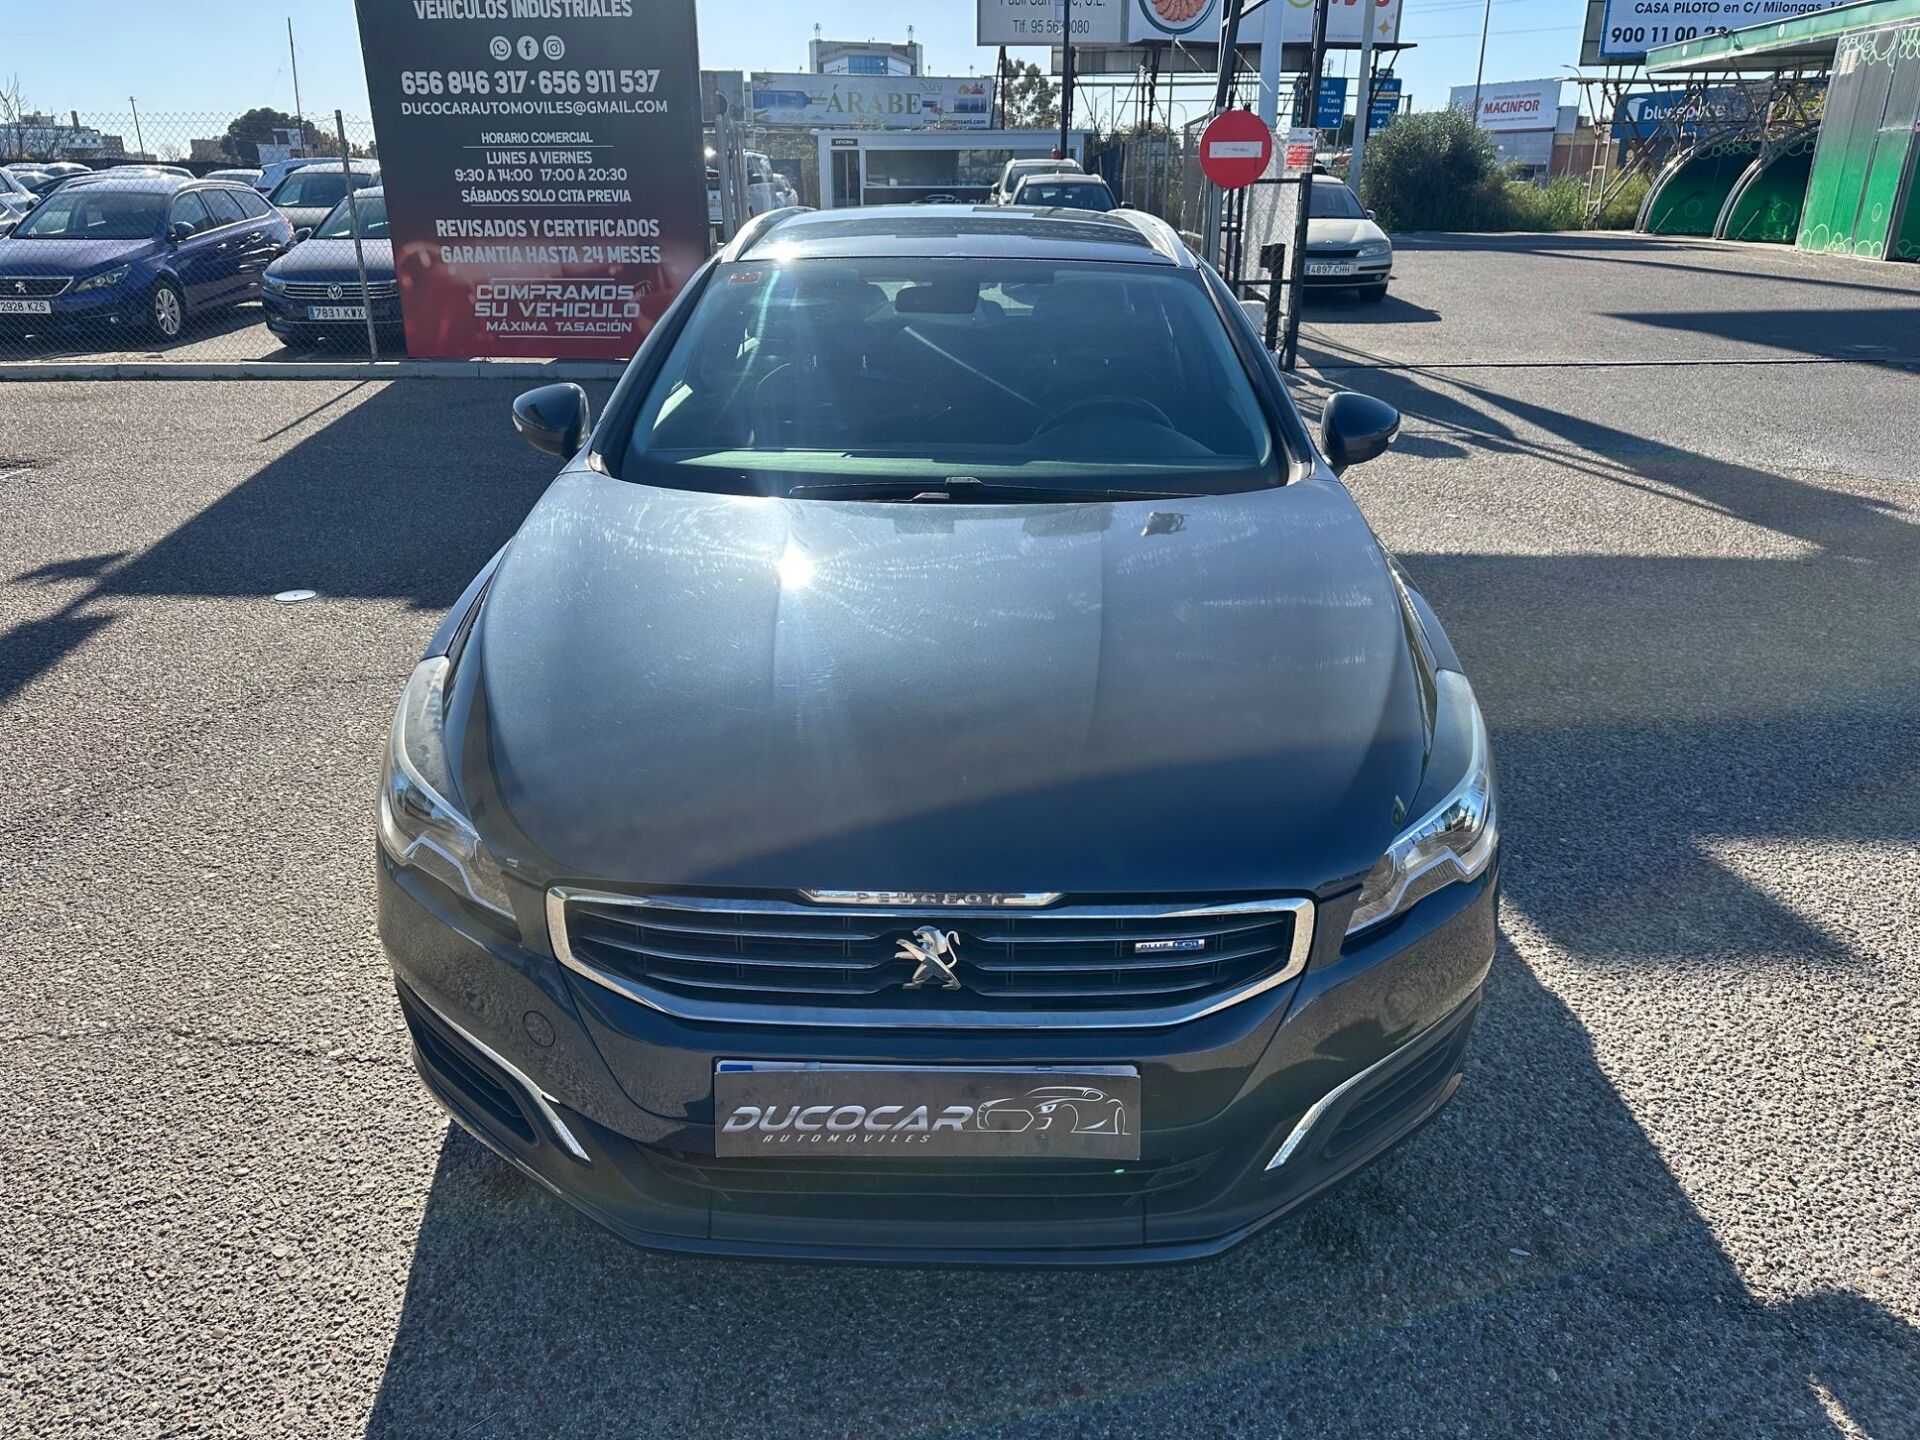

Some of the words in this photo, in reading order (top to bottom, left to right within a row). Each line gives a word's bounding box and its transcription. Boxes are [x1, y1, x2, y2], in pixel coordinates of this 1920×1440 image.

[512, 0, 633, 18] INDUSTRIALES
[1635, 3, 1669, 13] CASA
[1673, 2, 1719, 13] PILOTO
[1724, 5, 1739, 13] en
[1743, 2, 1760, 13] C/
[1013, 20, 1028, 33] Tlf.
[1031, 20, 1043, 33] 95
[1046, 20, 1090, 33] 56080
[1611, 28, 1645, 43] 900
[1651, 27, 1669, 42] 11
[1674, 26, 1697, 41] 00
[401, 71, 444, 95] 656
[448, 71, 490, 95] 846
[495, 71, 528, 94] 317
[538, 70, 580, 94] 656
[586, 70, 616, 93] 911
[620, 69, 661, 93] 537
[826, 84, 922, 115] ÁRABE
[1483, 100, 1540, 113] MACINFOR
[401, 100, 668, 115] DUCOCARAUTOMOVILES@GMAIL.COM
[481, 133, 529, 144] HORARIO
[531, 132, 593, 144] COMERCIAL
[486, 152, 527, 165] LUNES
[529, 152, 538, 164] A
[540, 151, 593, 164] VIERNES
[454, 169, 485, 182] 9:30
[487, 169, 496, 182] A
[498, 169, 533, 182] 14:00
[540, 169, 575, 181] 17:00
[577, 169, 586, 181] A
[588, 168, 628, 181] 20:30
[461, 187, 519, 203] SÁBADOS
[522, 190, 556, 202] SOLO
[558, 189, 585, 202] CITA
[587, 189, 632, 202] PREVIA
[435, 219, 526, 237] REVISADOS
[530, 219, 541, 237] Y
[543, 218, 660, 237] CERTIFICADOS
[440, 247, 525, 264] GARANTIA
[527, 246, 577, 263] HASTA
[582, 246, 603, 263] 24
[607, 245, 661, 263] MESES
[476, 284, 633, 300] COMPRAMOS
[28, 302, 46, 311] KZS
[316, 308, 340, 318] 7831
[474, 302, 508, 318] SU
[486, 319, 548, 333] MÁXIMA
[555, 318, 632, 333] TASACIÓN
[856, 892, 999, 904] PEUGEOT
[722, 1105, 974, 1132] DUCOCAR
